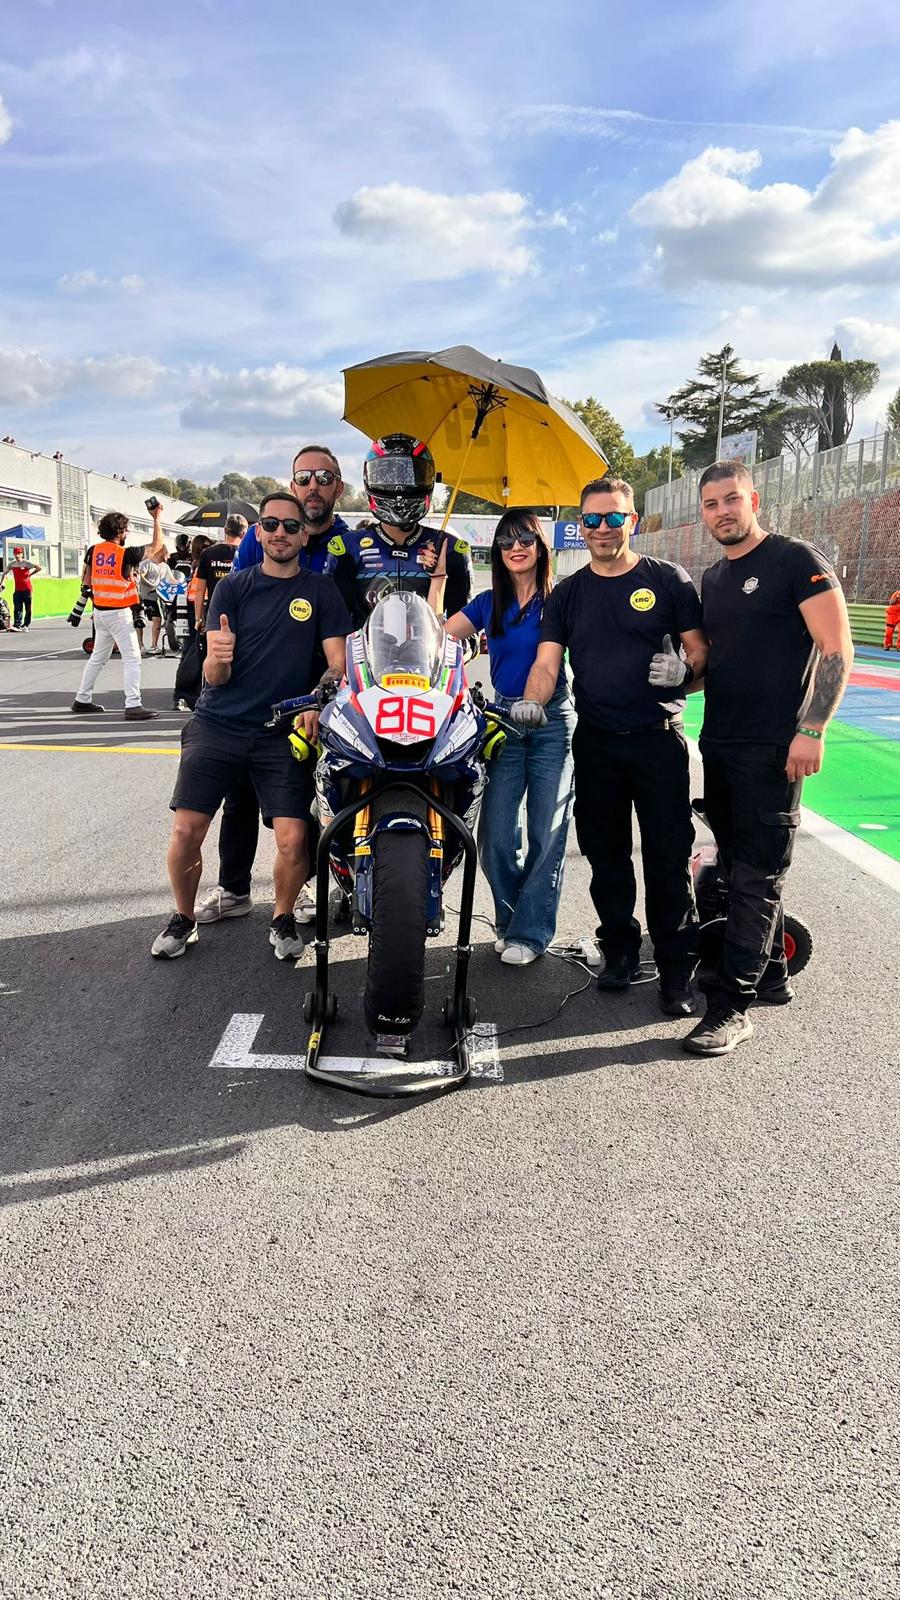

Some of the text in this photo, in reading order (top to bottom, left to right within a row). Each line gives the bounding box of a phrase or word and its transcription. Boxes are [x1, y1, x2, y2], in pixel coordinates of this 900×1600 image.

[95, 552, 116, 567] 84
[386, 675, 426, 689] PIRELLI
[375, 697, 435, 737] 86
